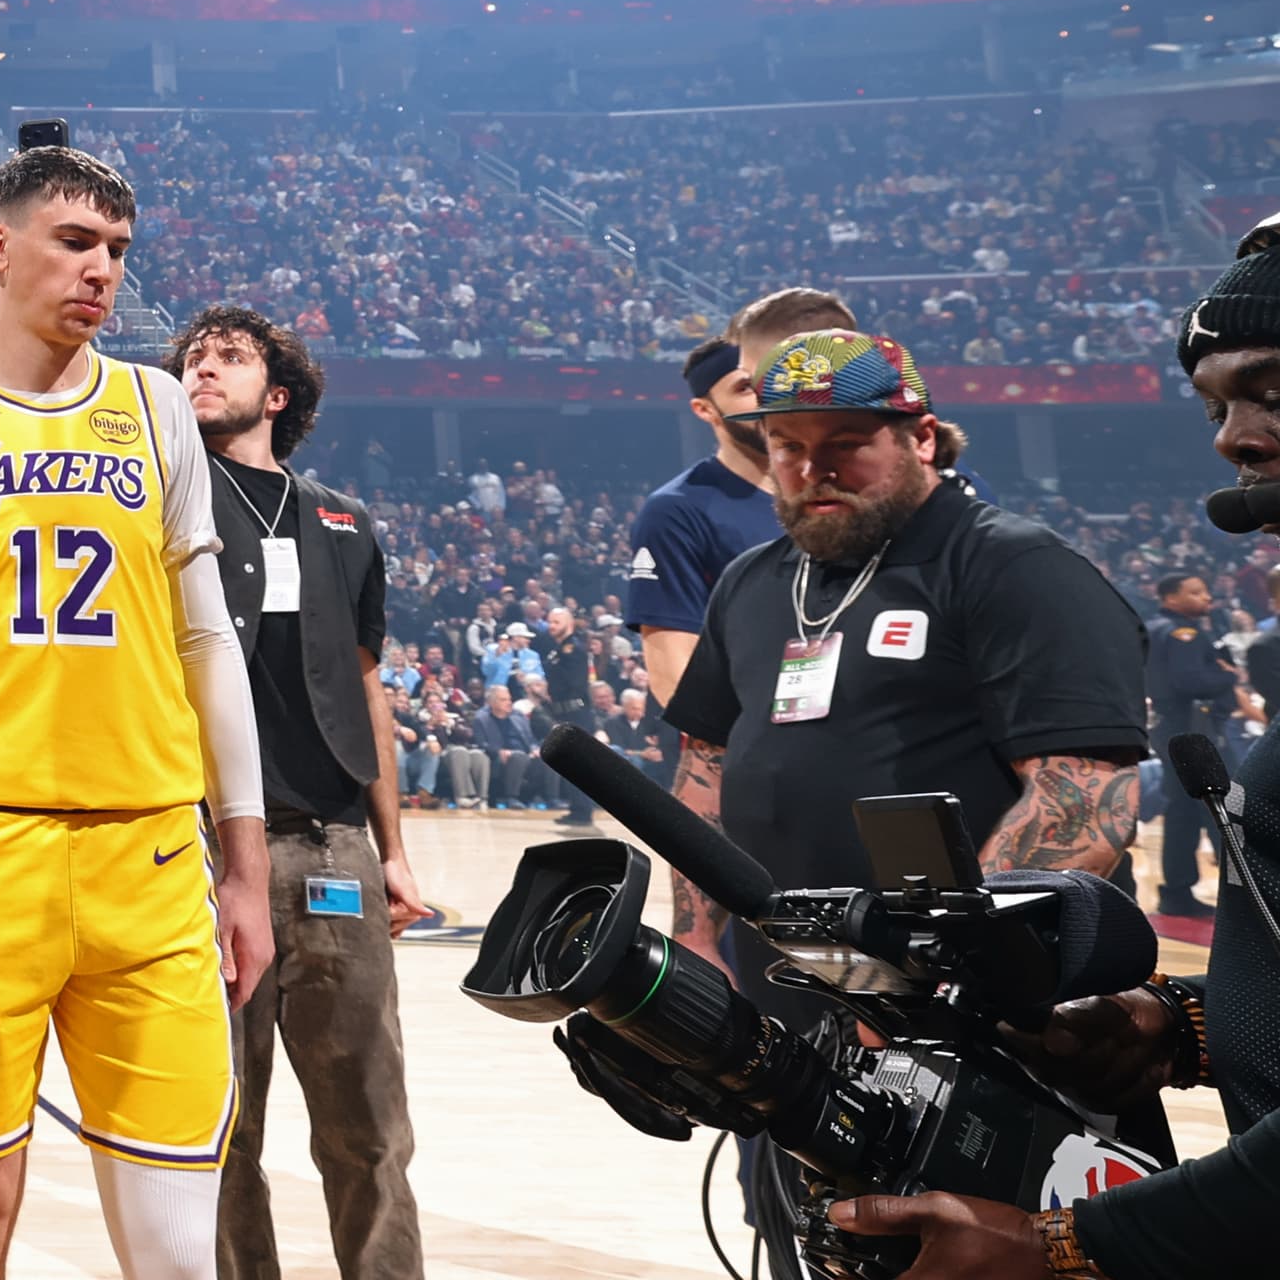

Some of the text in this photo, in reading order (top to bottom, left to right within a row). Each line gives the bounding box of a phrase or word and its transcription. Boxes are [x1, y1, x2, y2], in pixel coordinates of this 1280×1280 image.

[93, 416, 137, 435] bibigo
[8, 525, 119, 647] 12
[881, 621, 913, 647] E
[835, 1089, 865, 1113] Canon
